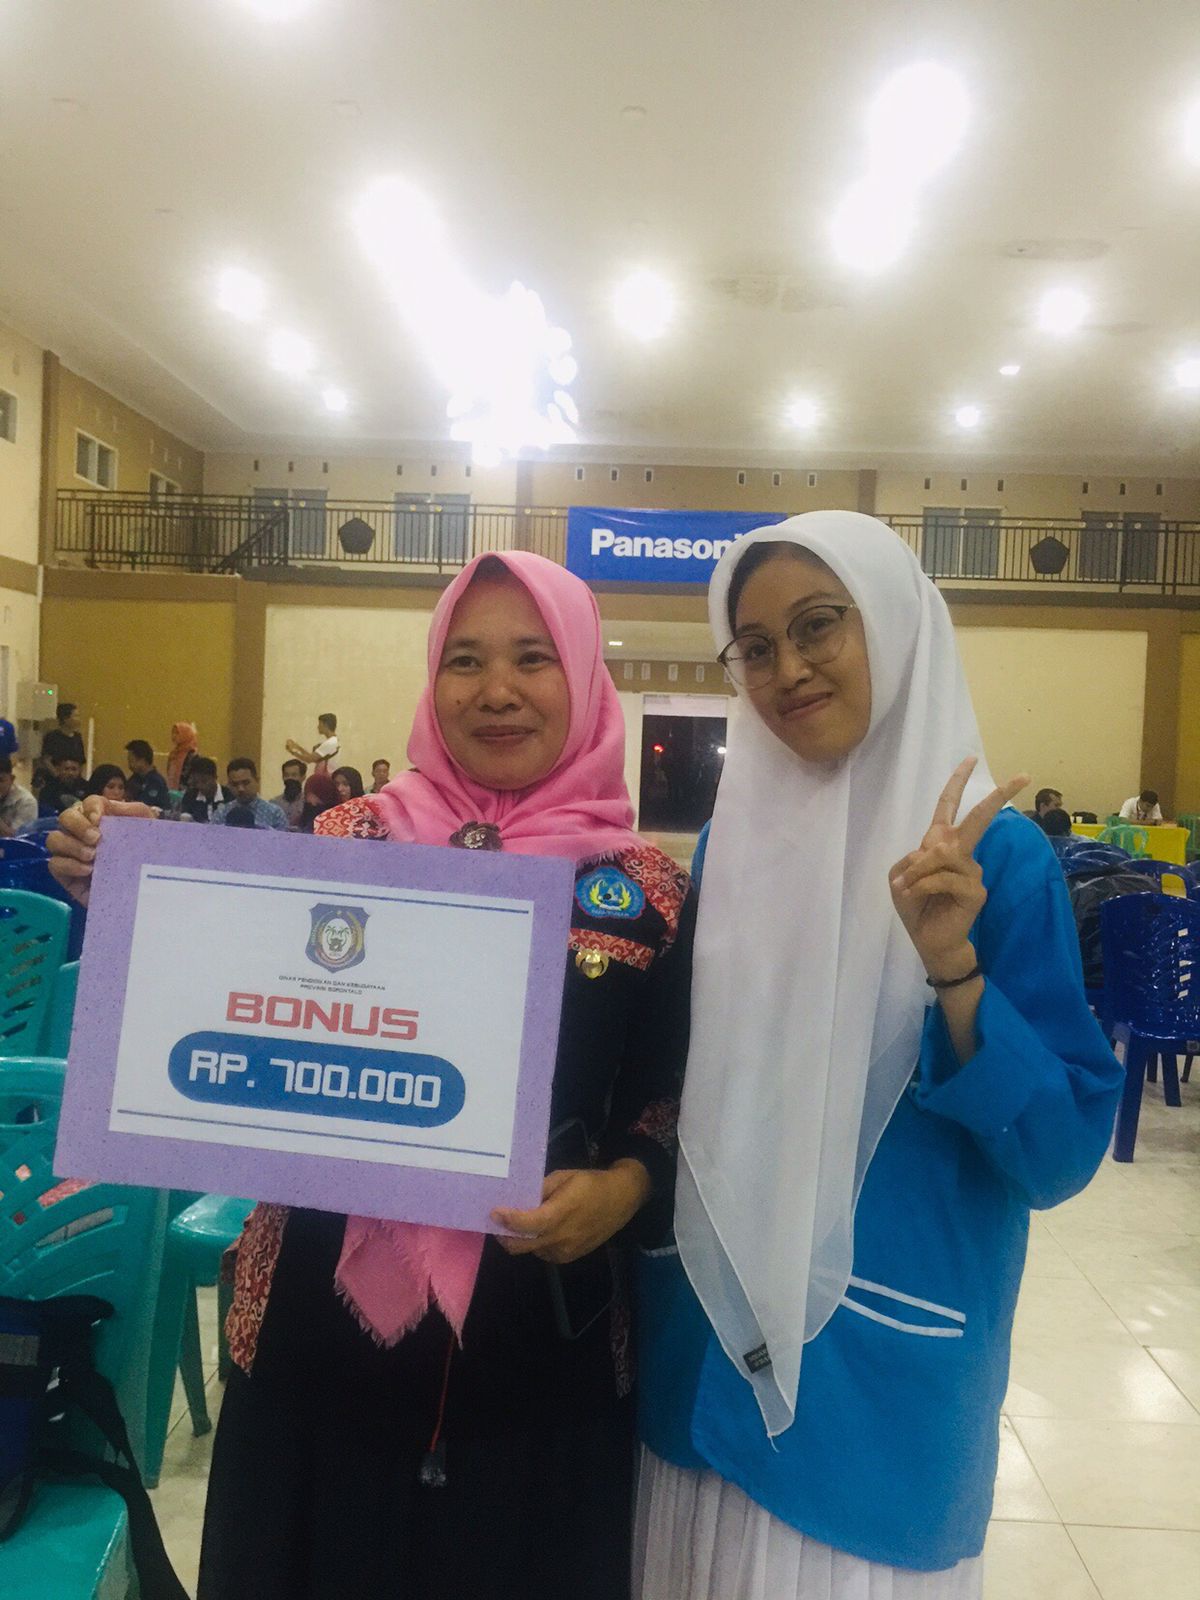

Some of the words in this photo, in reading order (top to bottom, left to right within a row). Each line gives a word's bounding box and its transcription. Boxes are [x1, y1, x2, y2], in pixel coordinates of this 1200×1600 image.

[590, 528, 743, 560] Panason
[226, 992, 418, 1040] BONUS
[189, 1049, 255, 1088] RP.
[269, 1058, 442, 1109] 700.000
